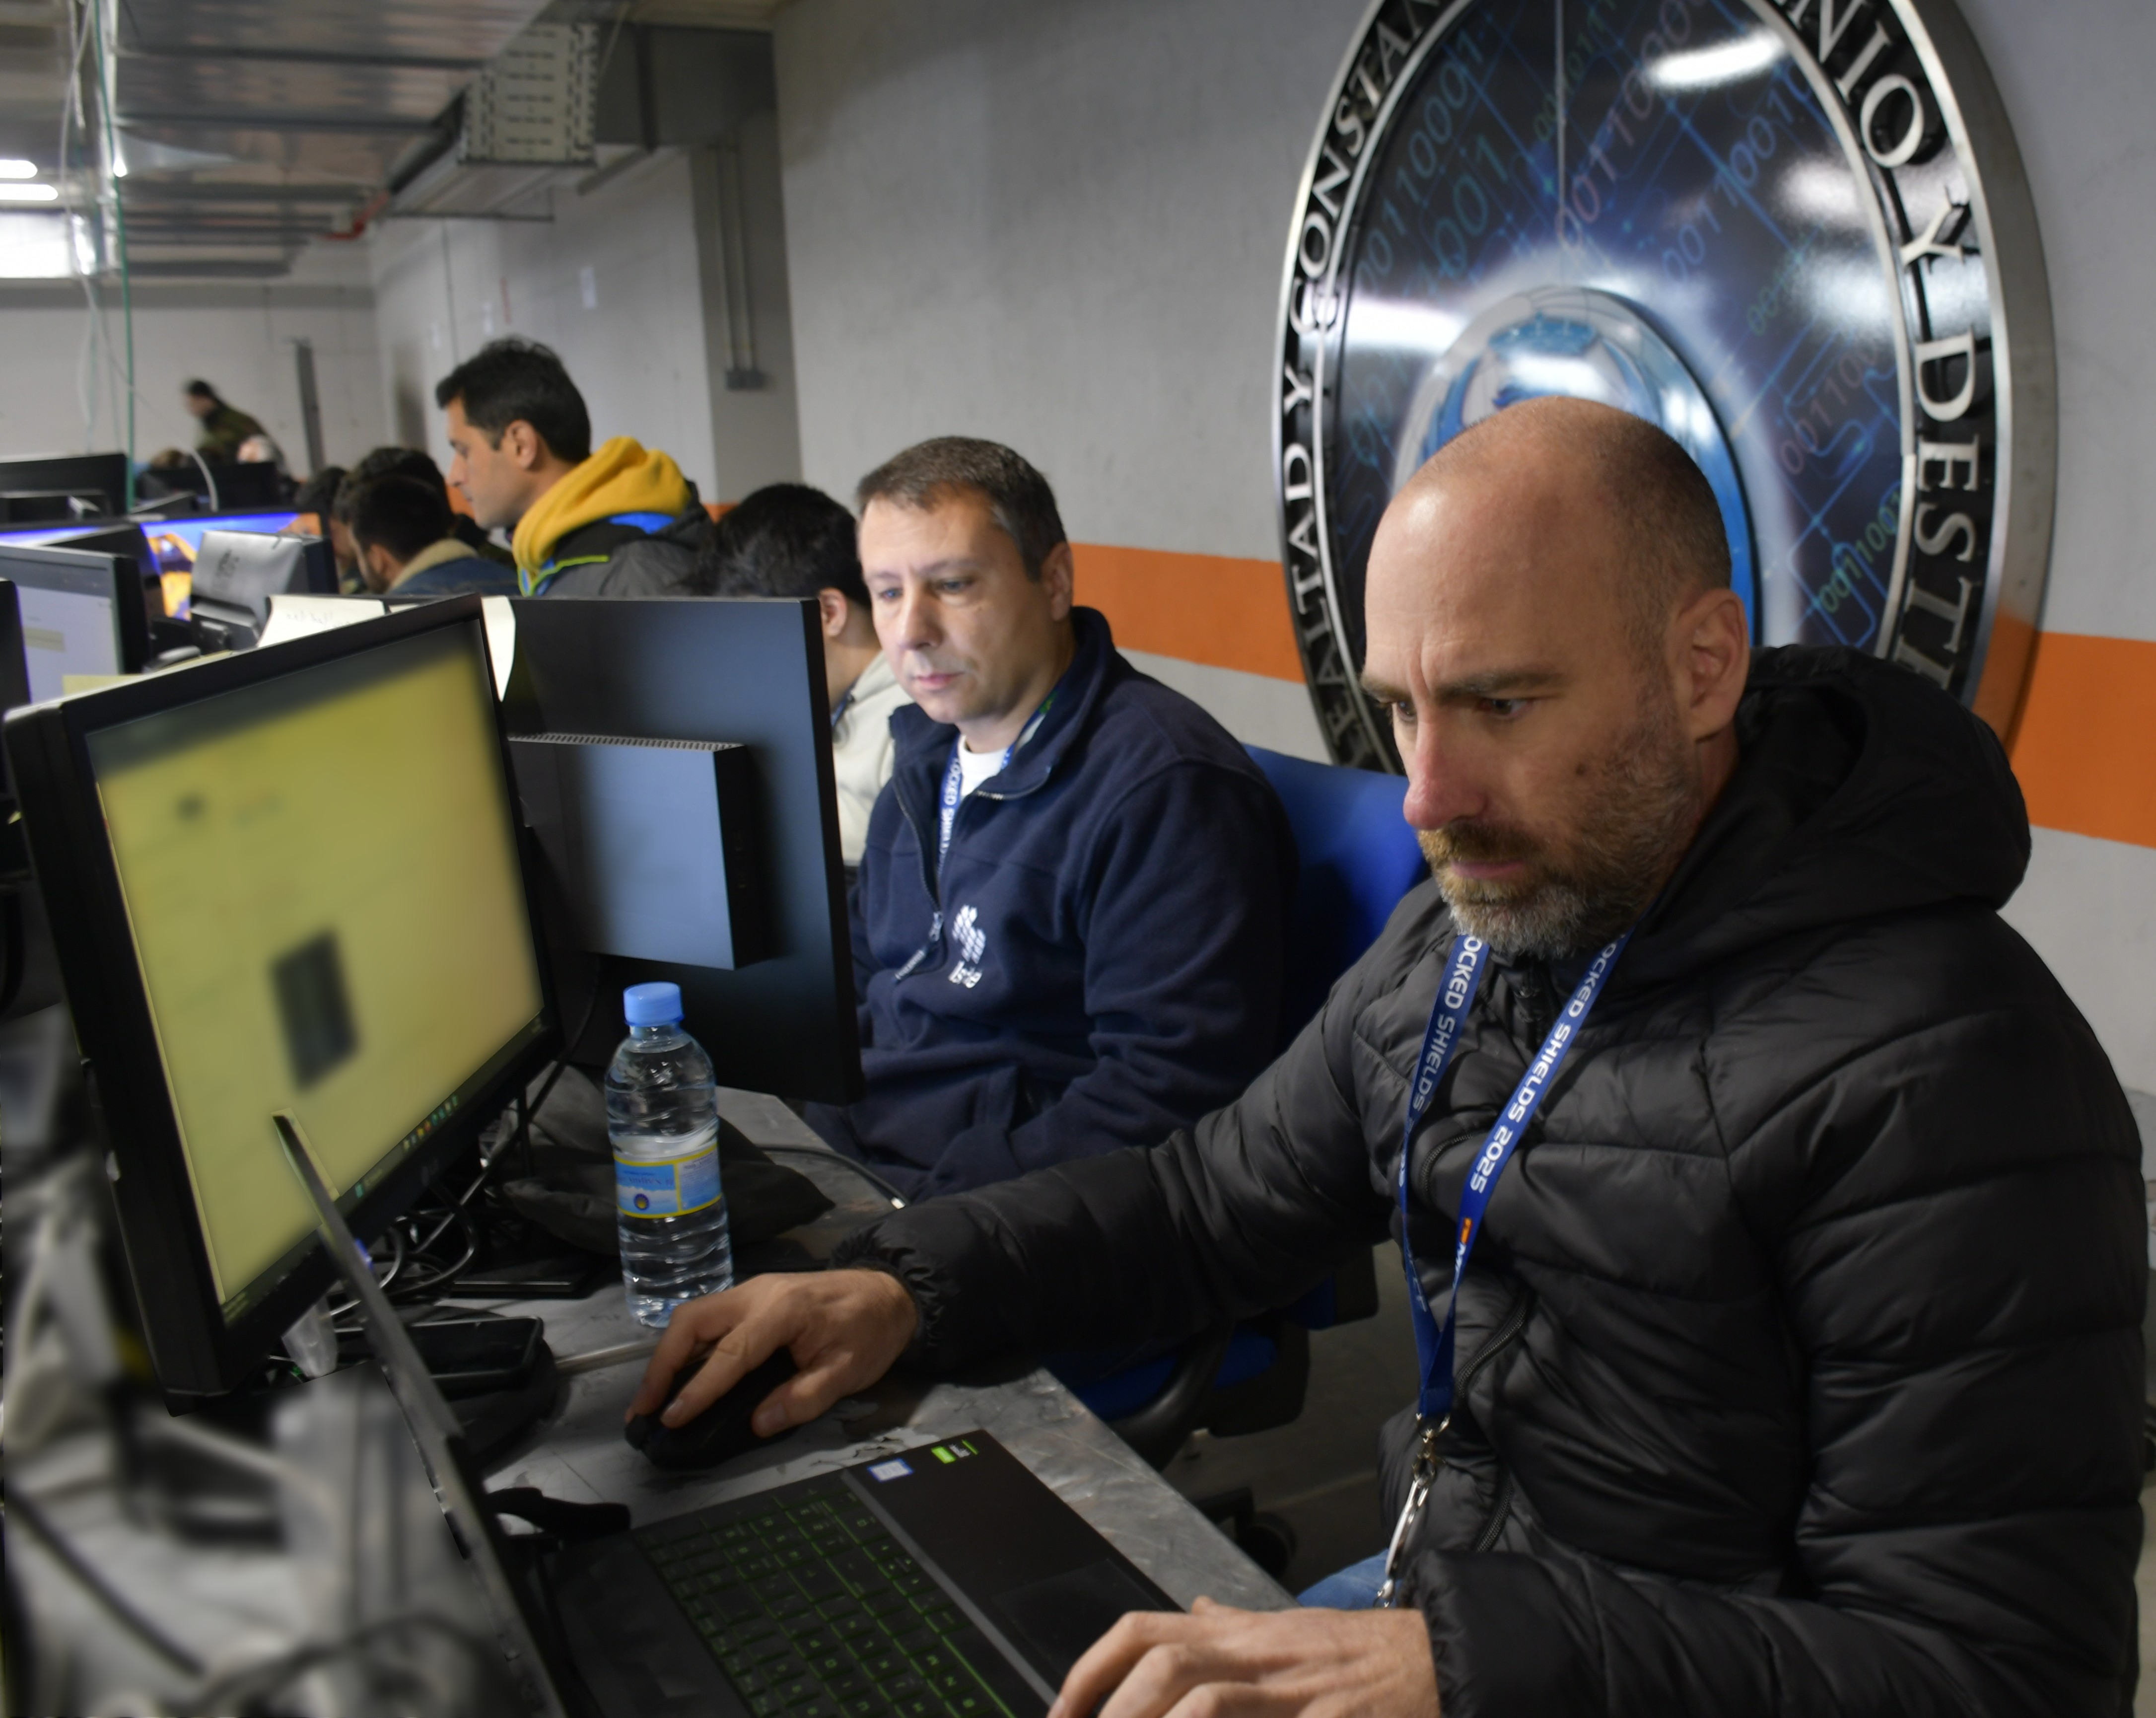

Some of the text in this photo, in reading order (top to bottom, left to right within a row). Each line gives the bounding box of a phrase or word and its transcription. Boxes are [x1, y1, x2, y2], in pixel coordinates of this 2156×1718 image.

[1772, 0, 1924, 168] NIO
[1899, 184, 1966, 274] Y
[1284, 362, 1312, 416] Y
[1412, 935, 1483, 1112] OCKED SHIELDS
[1470, 937, 1620, 1193] OCKED SHIELDS 2025
